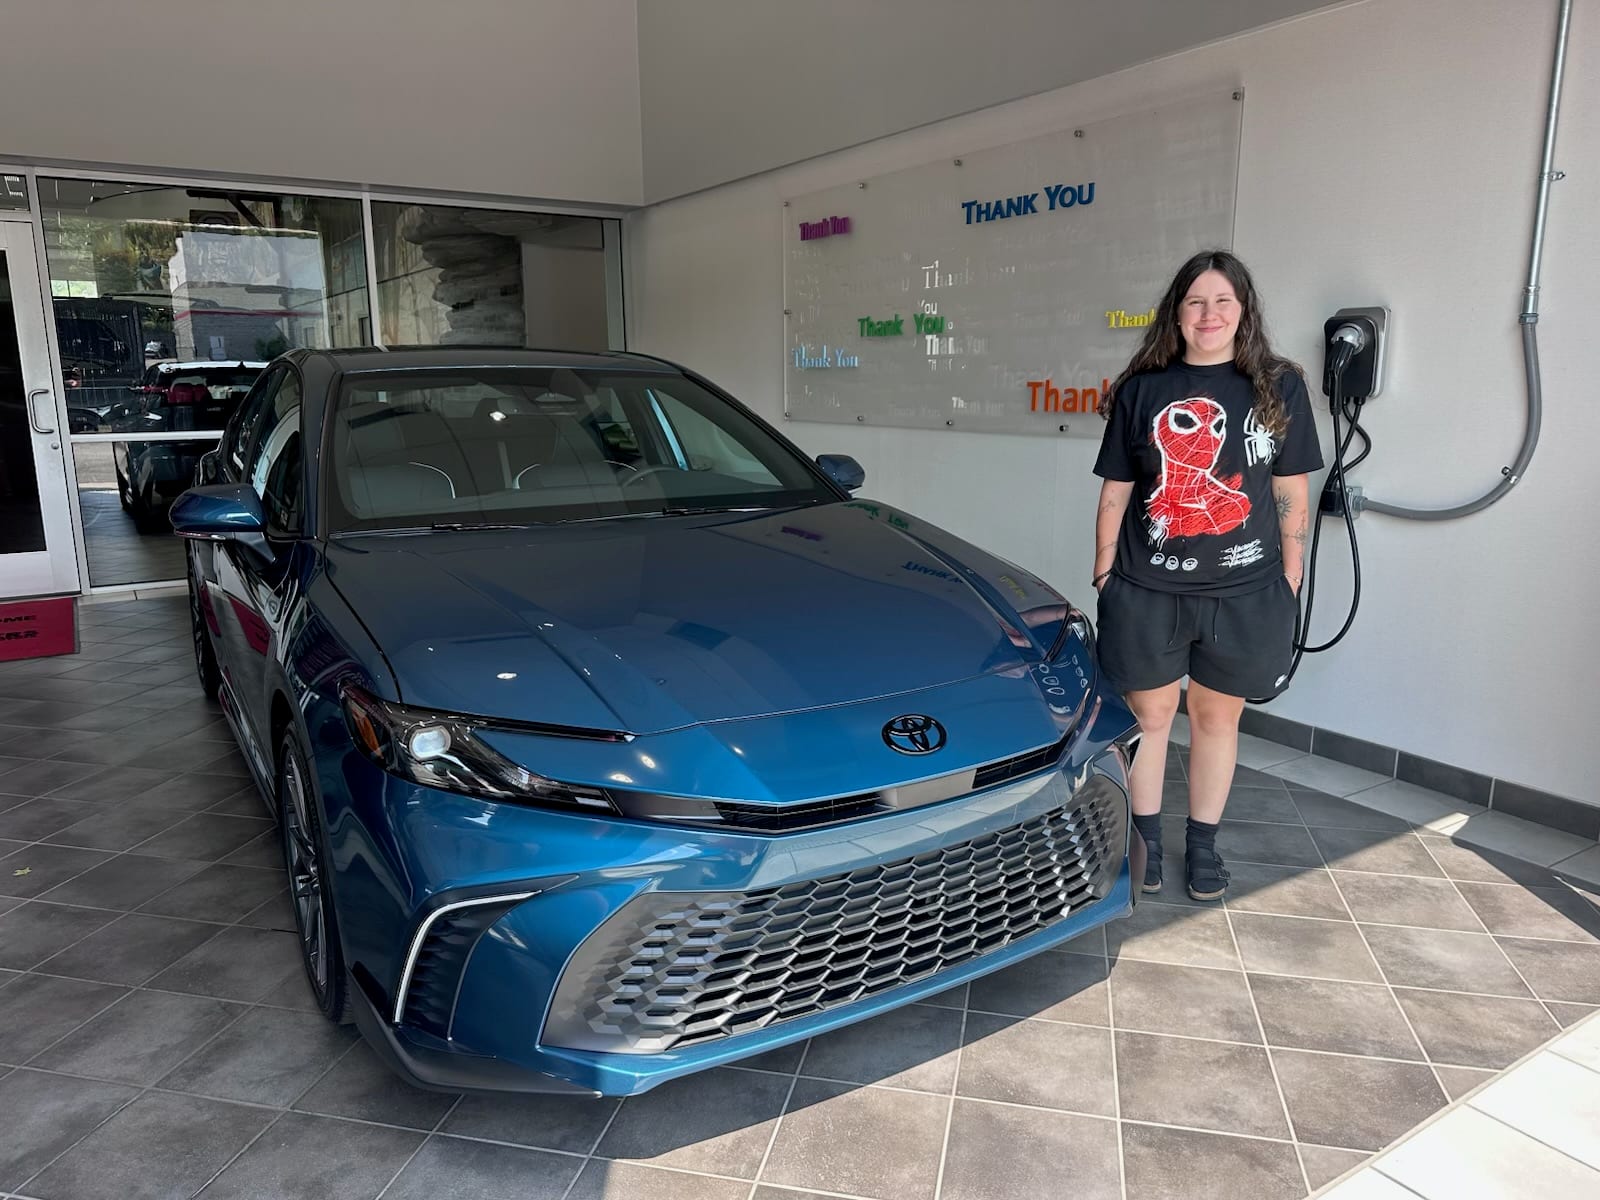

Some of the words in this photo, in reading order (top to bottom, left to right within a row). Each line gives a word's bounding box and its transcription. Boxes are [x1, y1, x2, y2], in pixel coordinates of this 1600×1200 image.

[799, 217, 830, 241] Thank
[830, 215, 850, 235] You
[857, 314, 905, 337] Thank
[913, 312, 946, 336] You
[792, 343, 832, 368] Thank
[835, 348, 859, 368] You
